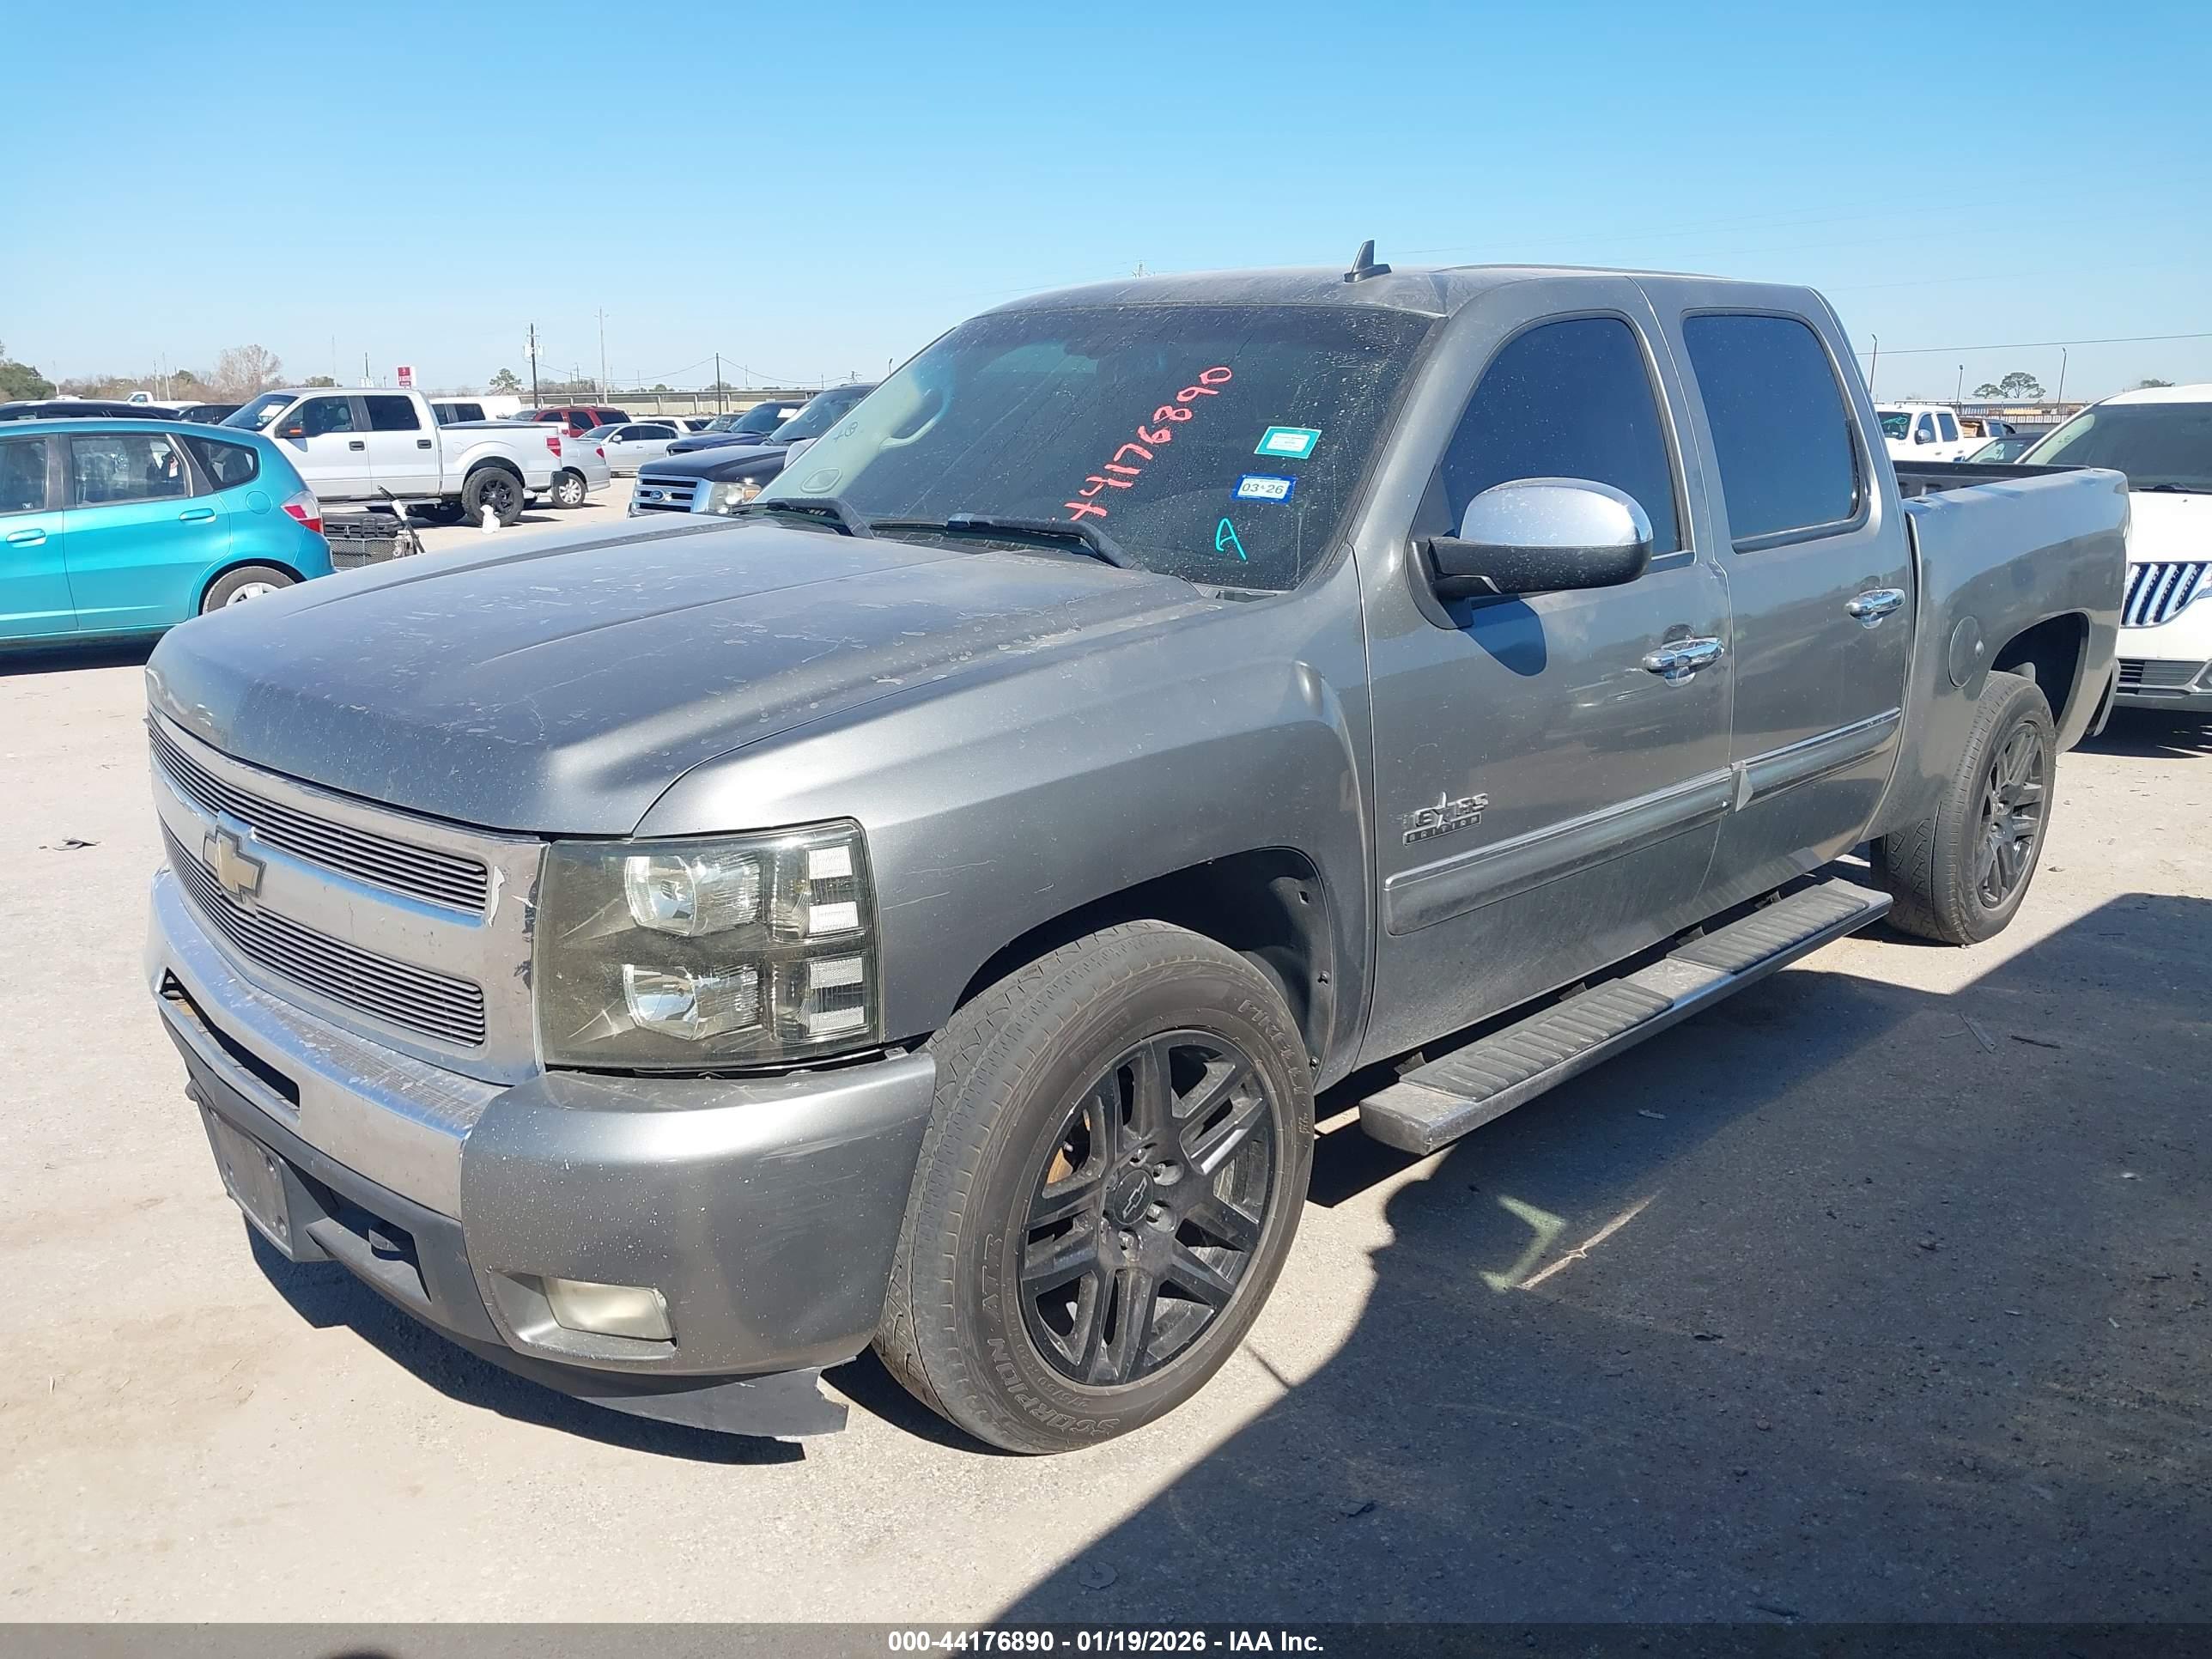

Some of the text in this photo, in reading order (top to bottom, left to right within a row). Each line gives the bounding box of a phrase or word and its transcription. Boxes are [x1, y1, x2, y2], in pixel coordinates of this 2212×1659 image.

[1064, 366, 1232, 521] 44176890
[1215, 517, 1248, 562] A
[987, 1338, 1120, 1437] SCORPION
